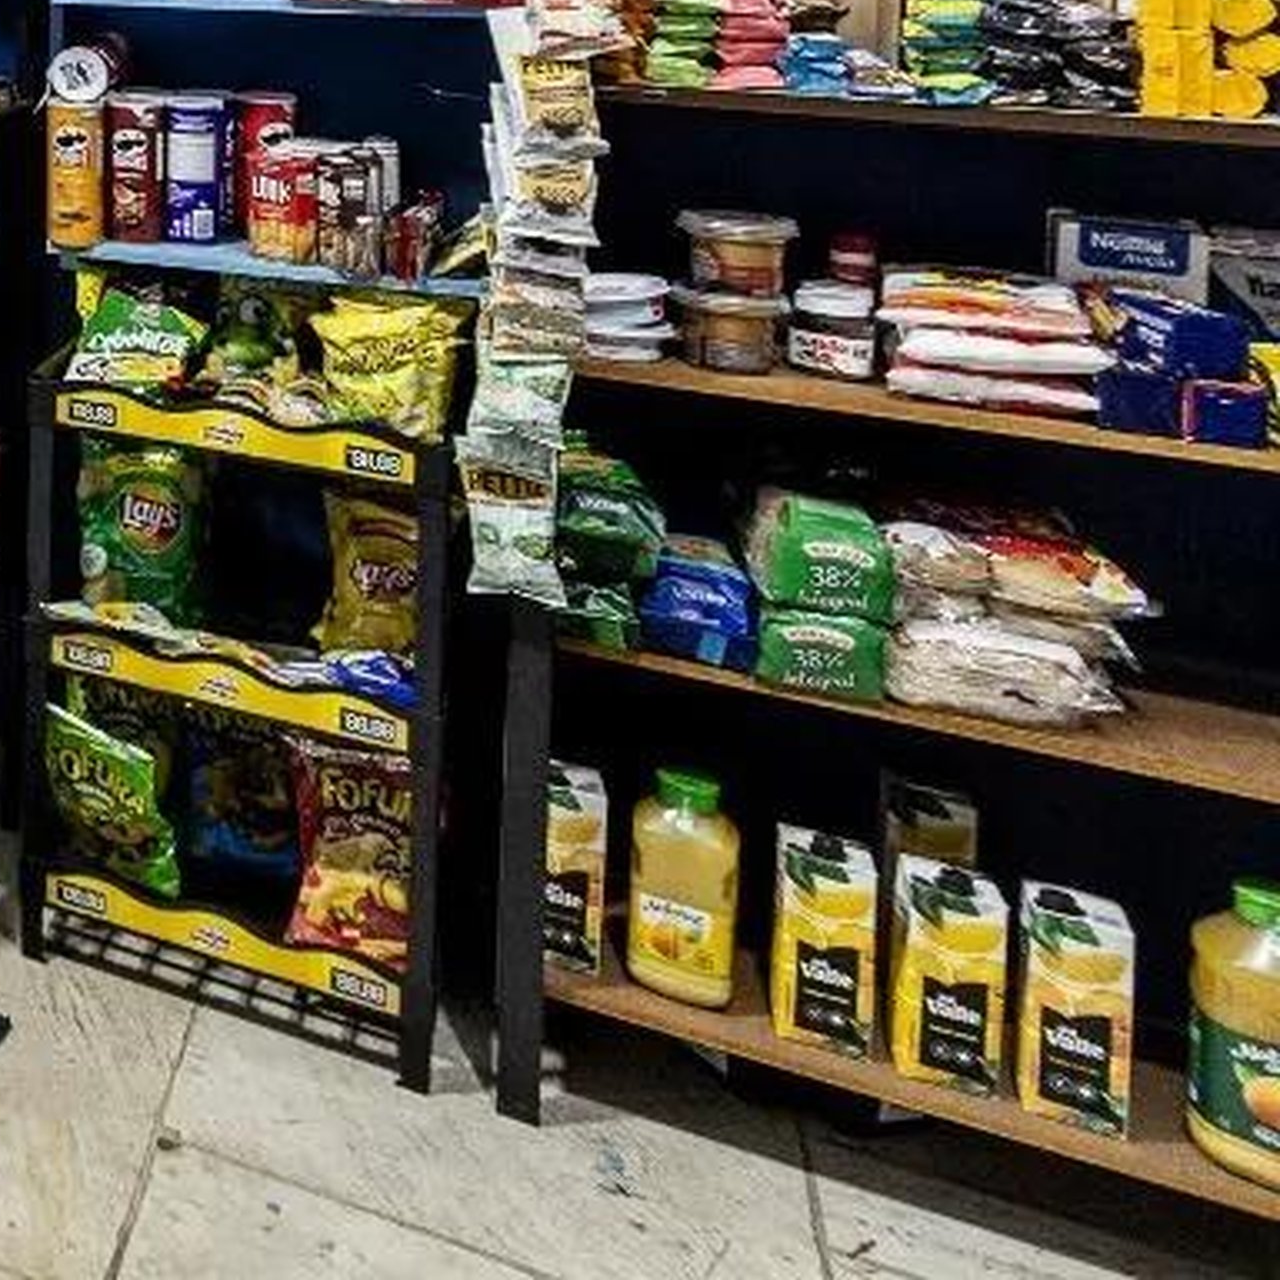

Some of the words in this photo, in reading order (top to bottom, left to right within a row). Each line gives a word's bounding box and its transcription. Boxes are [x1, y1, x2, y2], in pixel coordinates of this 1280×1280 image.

[120, 492, 182, 543] Lay's
[808, 565, 862, 588] 38%
[791, 648, 845, 669] 38%
